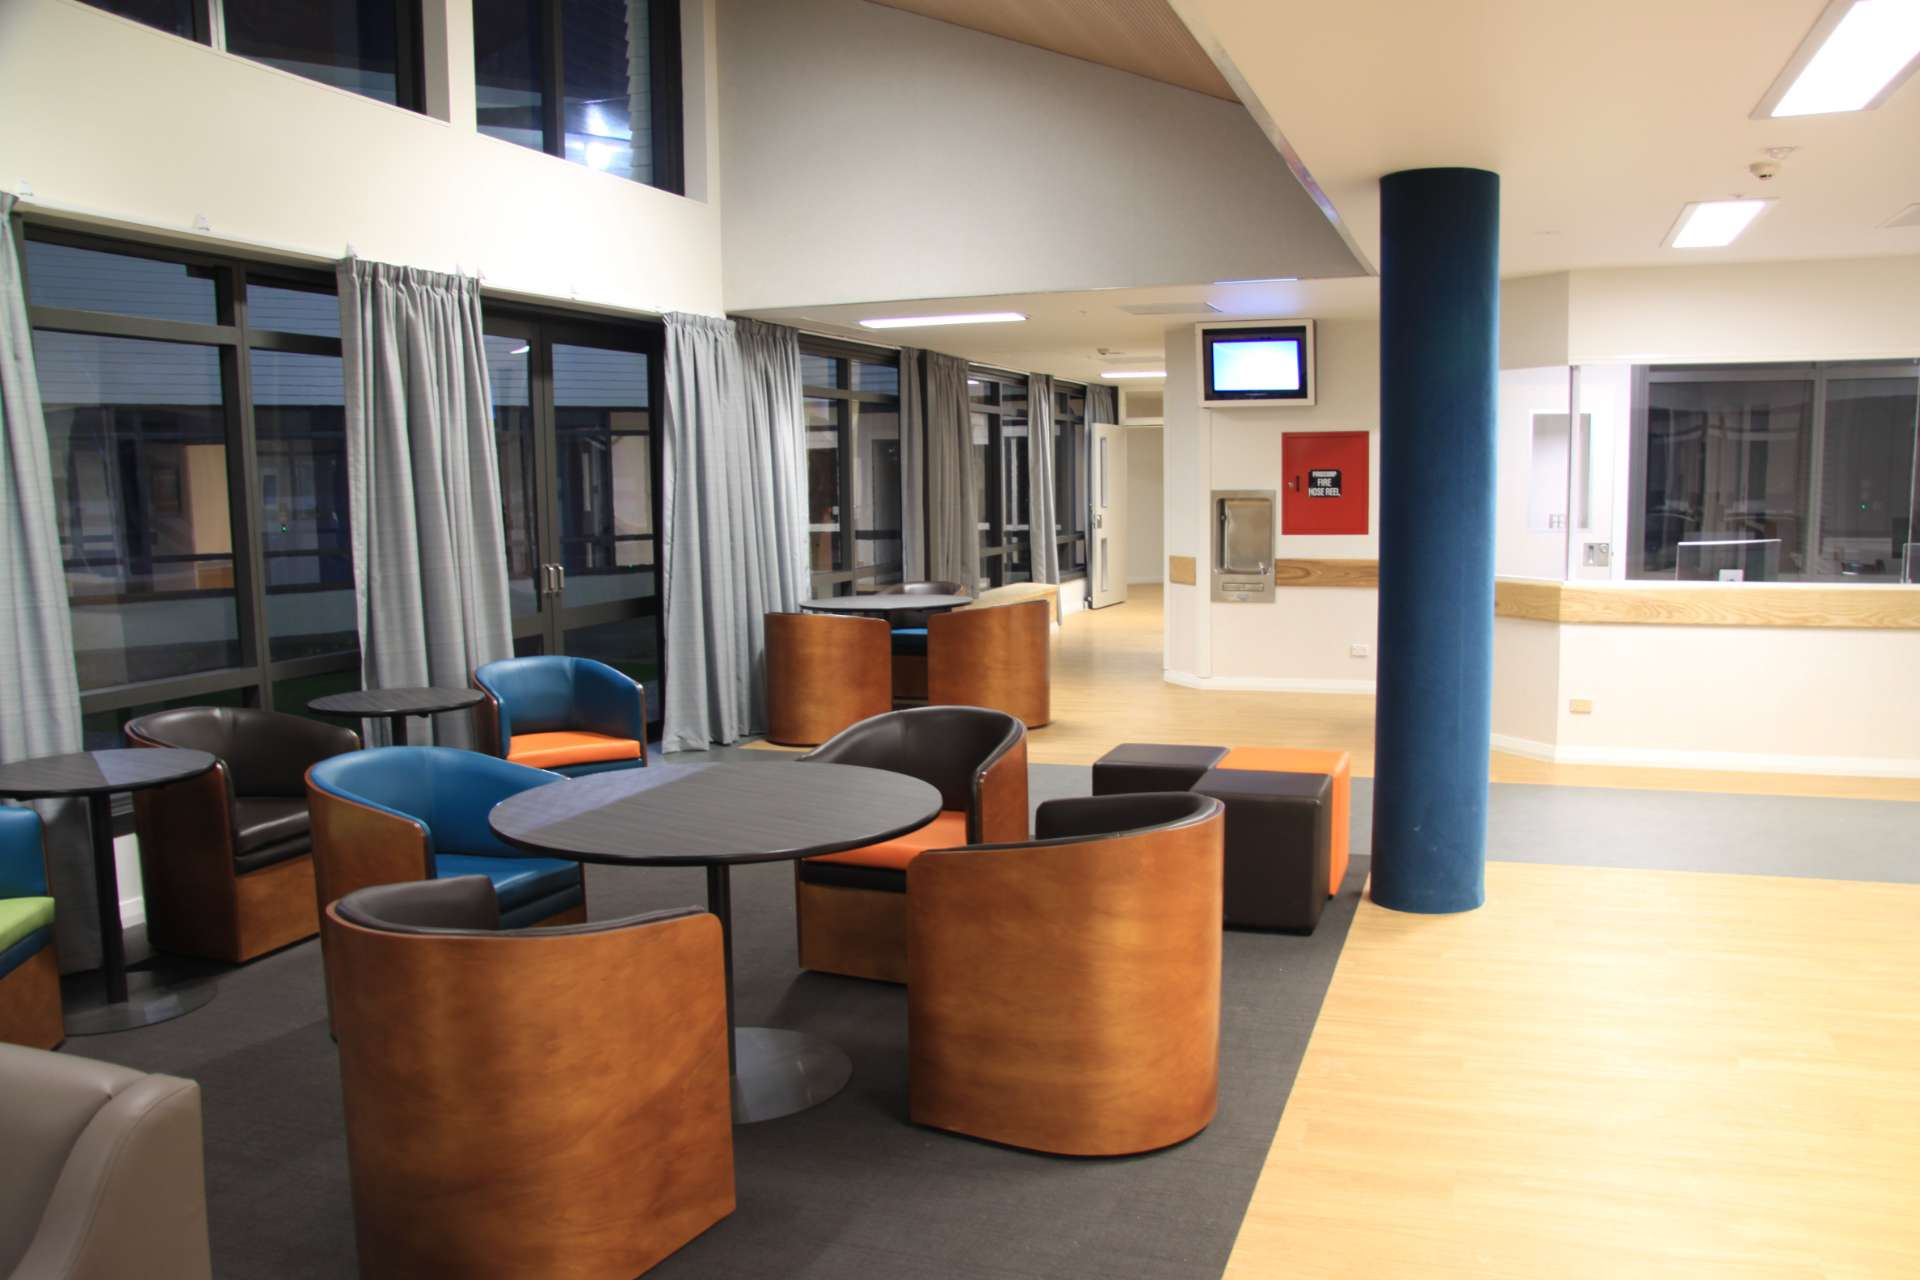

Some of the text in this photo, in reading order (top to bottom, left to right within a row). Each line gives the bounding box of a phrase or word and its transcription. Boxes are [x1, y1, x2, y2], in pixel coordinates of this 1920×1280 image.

[1317, 478, 1331, 487] FIRE
[1309, 488, 1340, 496] HOSE REEL
